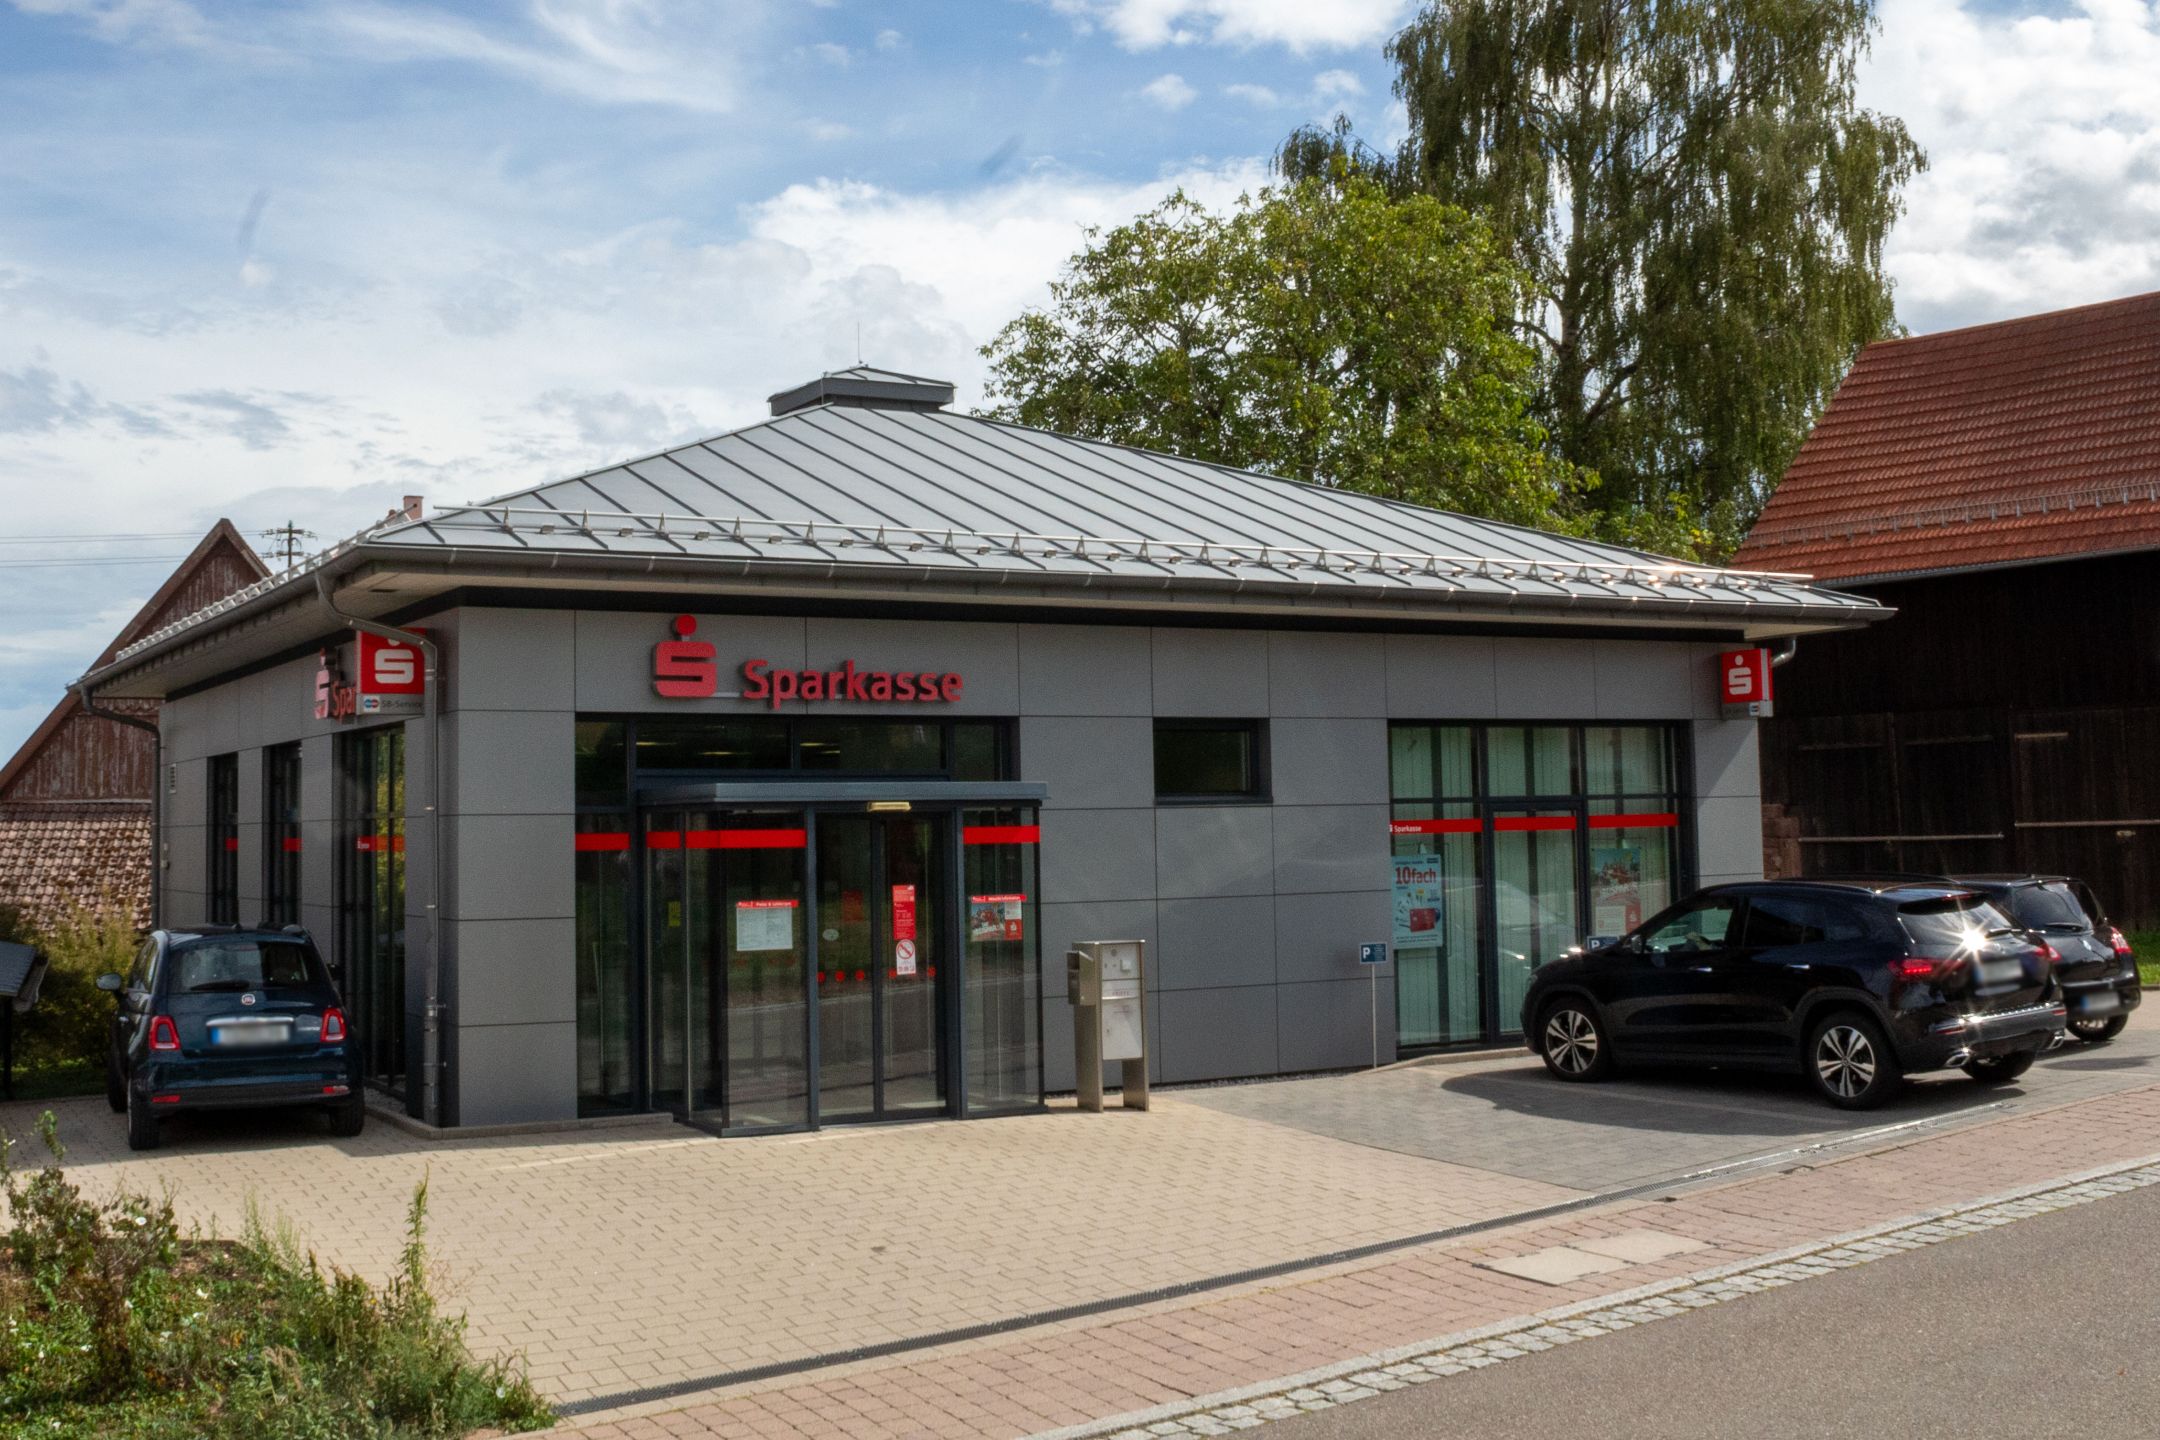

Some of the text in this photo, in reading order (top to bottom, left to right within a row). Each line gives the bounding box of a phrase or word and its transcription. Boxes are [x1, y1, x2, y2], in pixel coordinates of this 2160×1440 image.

[742, 659, 963, 710] Sparkasse
[1395, 866, 1437, 885] 10fach
[1362, 946, 1371, 960] P
